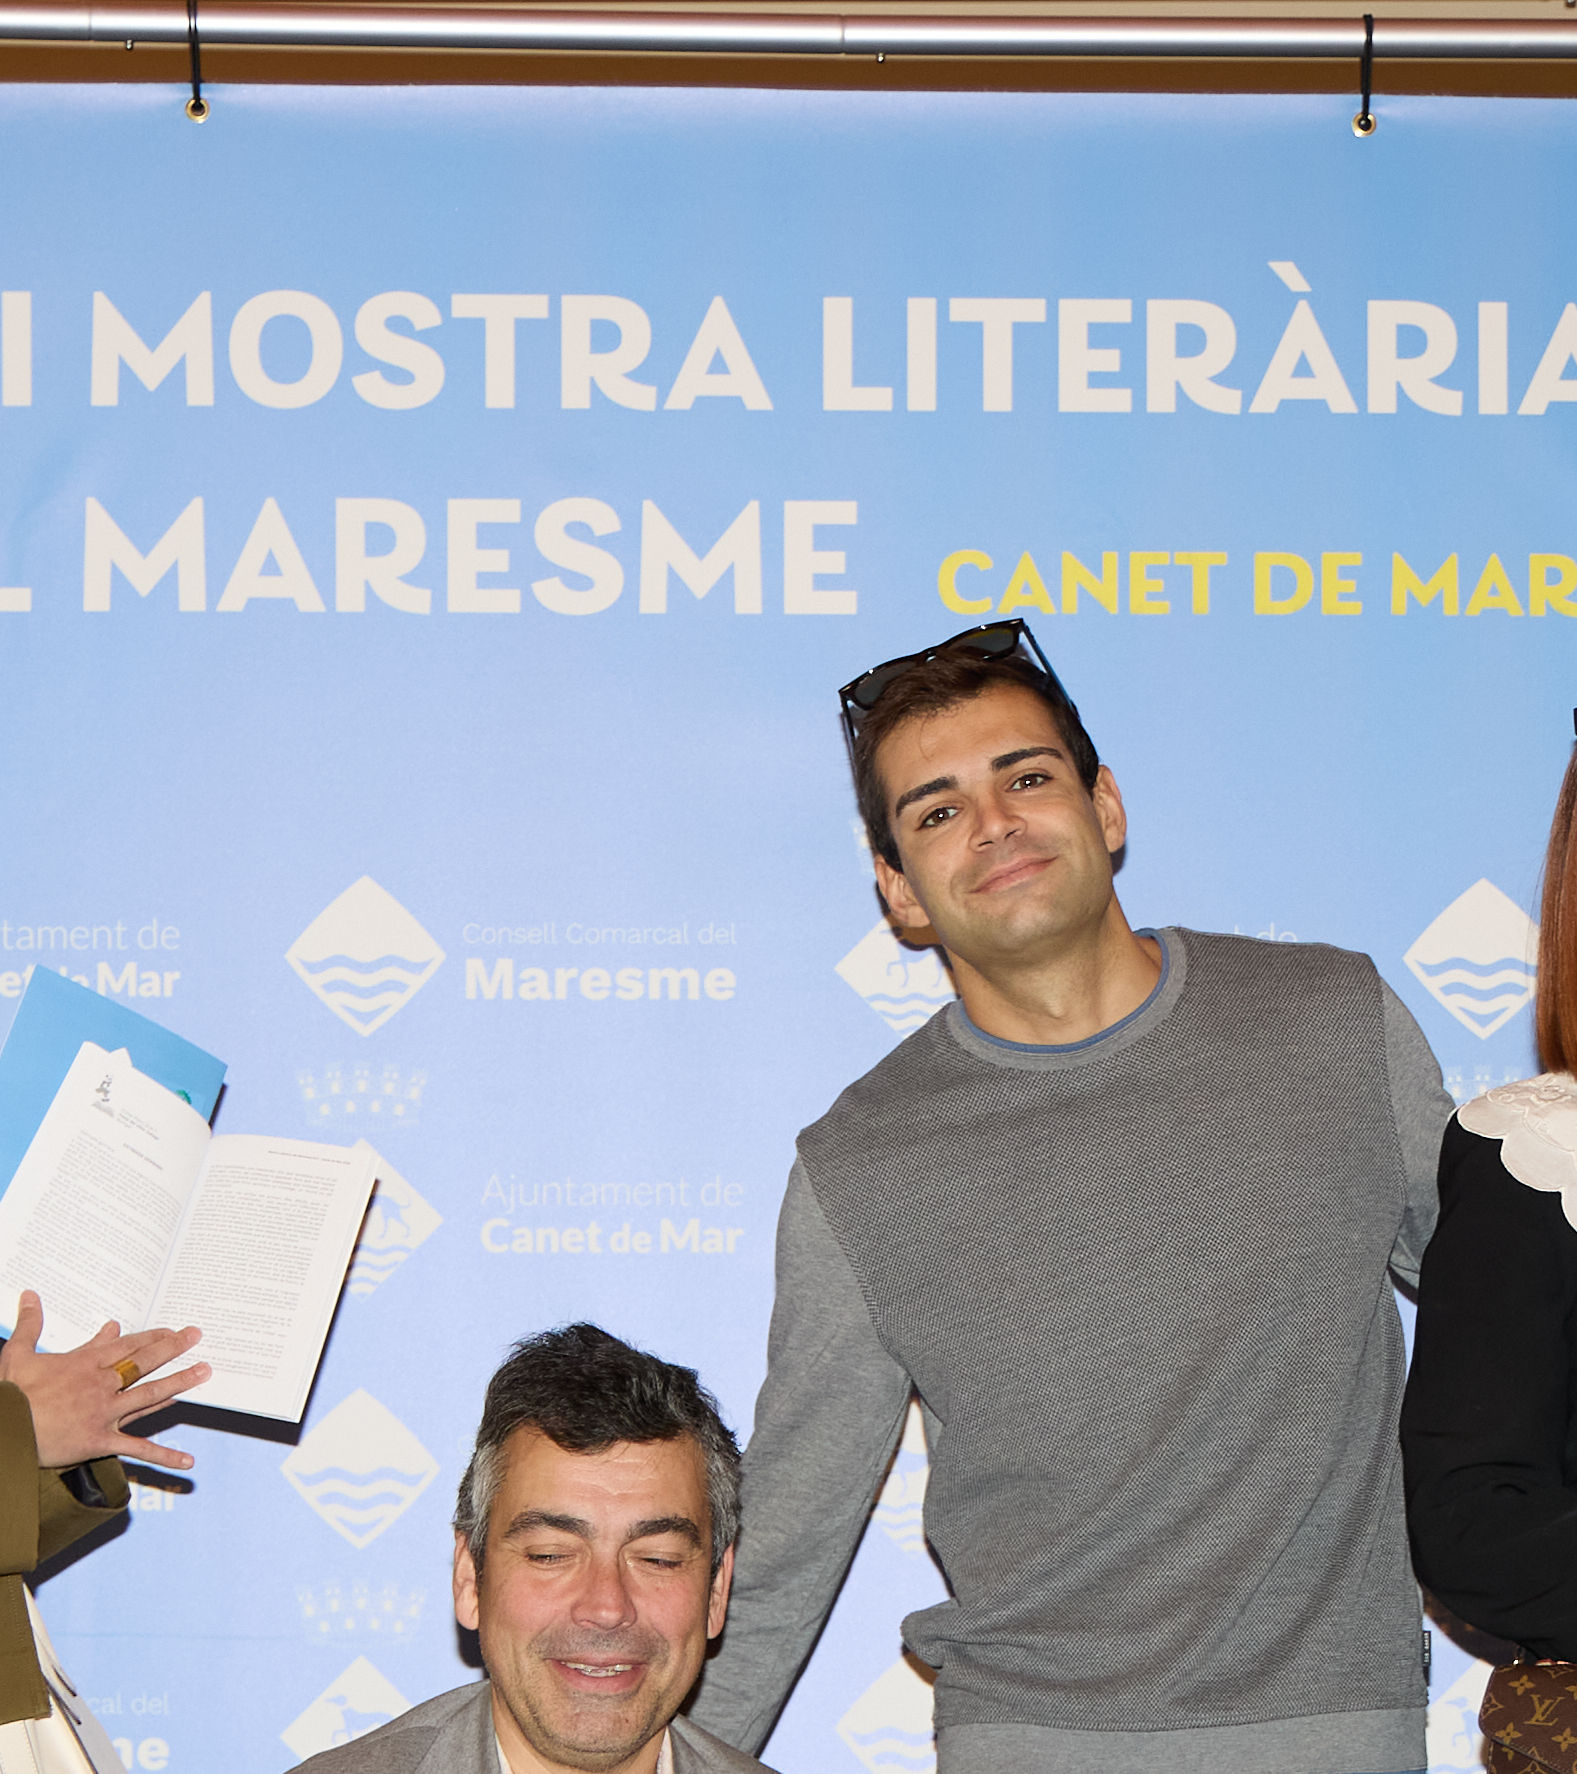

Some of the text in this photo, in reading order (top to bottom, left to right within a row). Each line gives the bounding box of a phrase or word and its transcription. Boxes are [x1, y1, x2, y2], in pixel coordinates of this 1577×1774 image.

[90, 289, 774, 411] MOSTRA
[82, 496, 858, 616] MARESME
[938, 550, 1227, 615] CANET
[1254, 552, 1362, 615] DE
[137, 917, 180, 950] de
[462, 922, 737, 945] Consell Comarcal del
[97, 962, 181, 998] Mar
[465, 957, 737, 1001] Maresme
[481, 1173, 744, 1214] Ajuntament de
[480, 1217, 744, 1253] Canet de Mar
[131, 1691, 170, 1716] del
